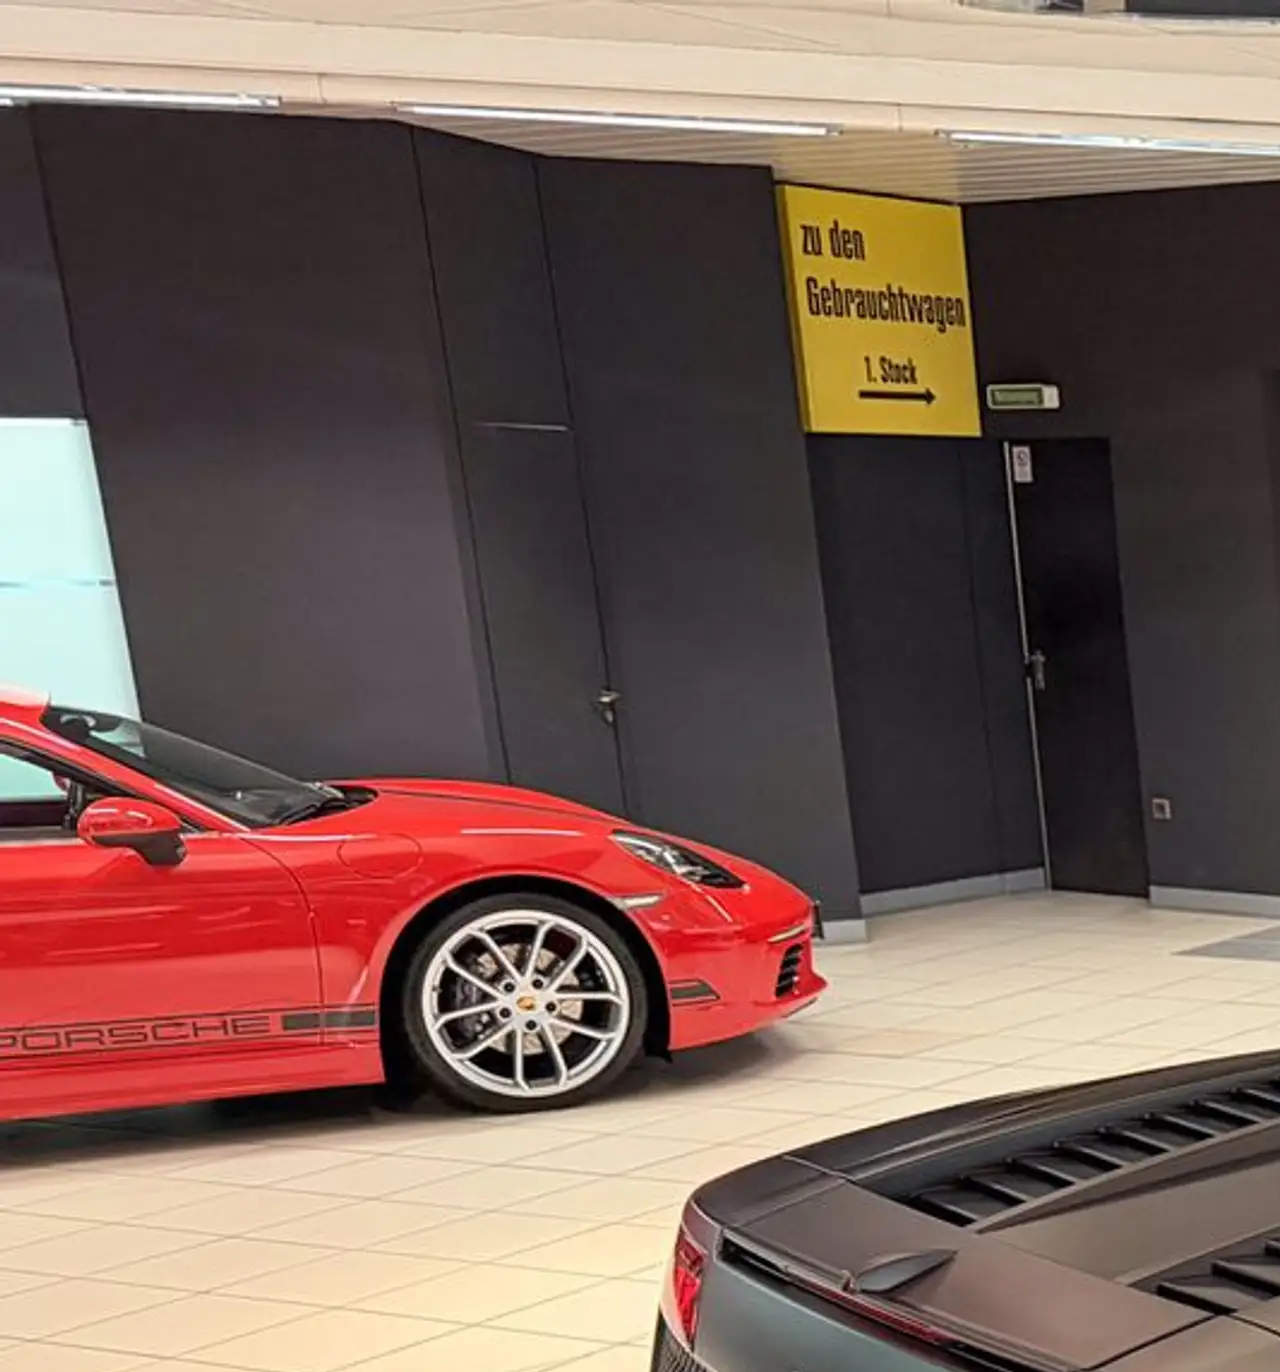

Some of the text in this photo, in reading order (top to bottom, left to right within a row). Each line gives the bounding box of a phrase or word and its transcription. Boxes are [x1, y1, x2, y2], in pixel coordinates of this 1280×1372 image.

[800, 219, 866, 261] zu den
[805, 276, 967, 334] Gebrauchtwagen
[864, 355, 918, 384] 1. Stock
